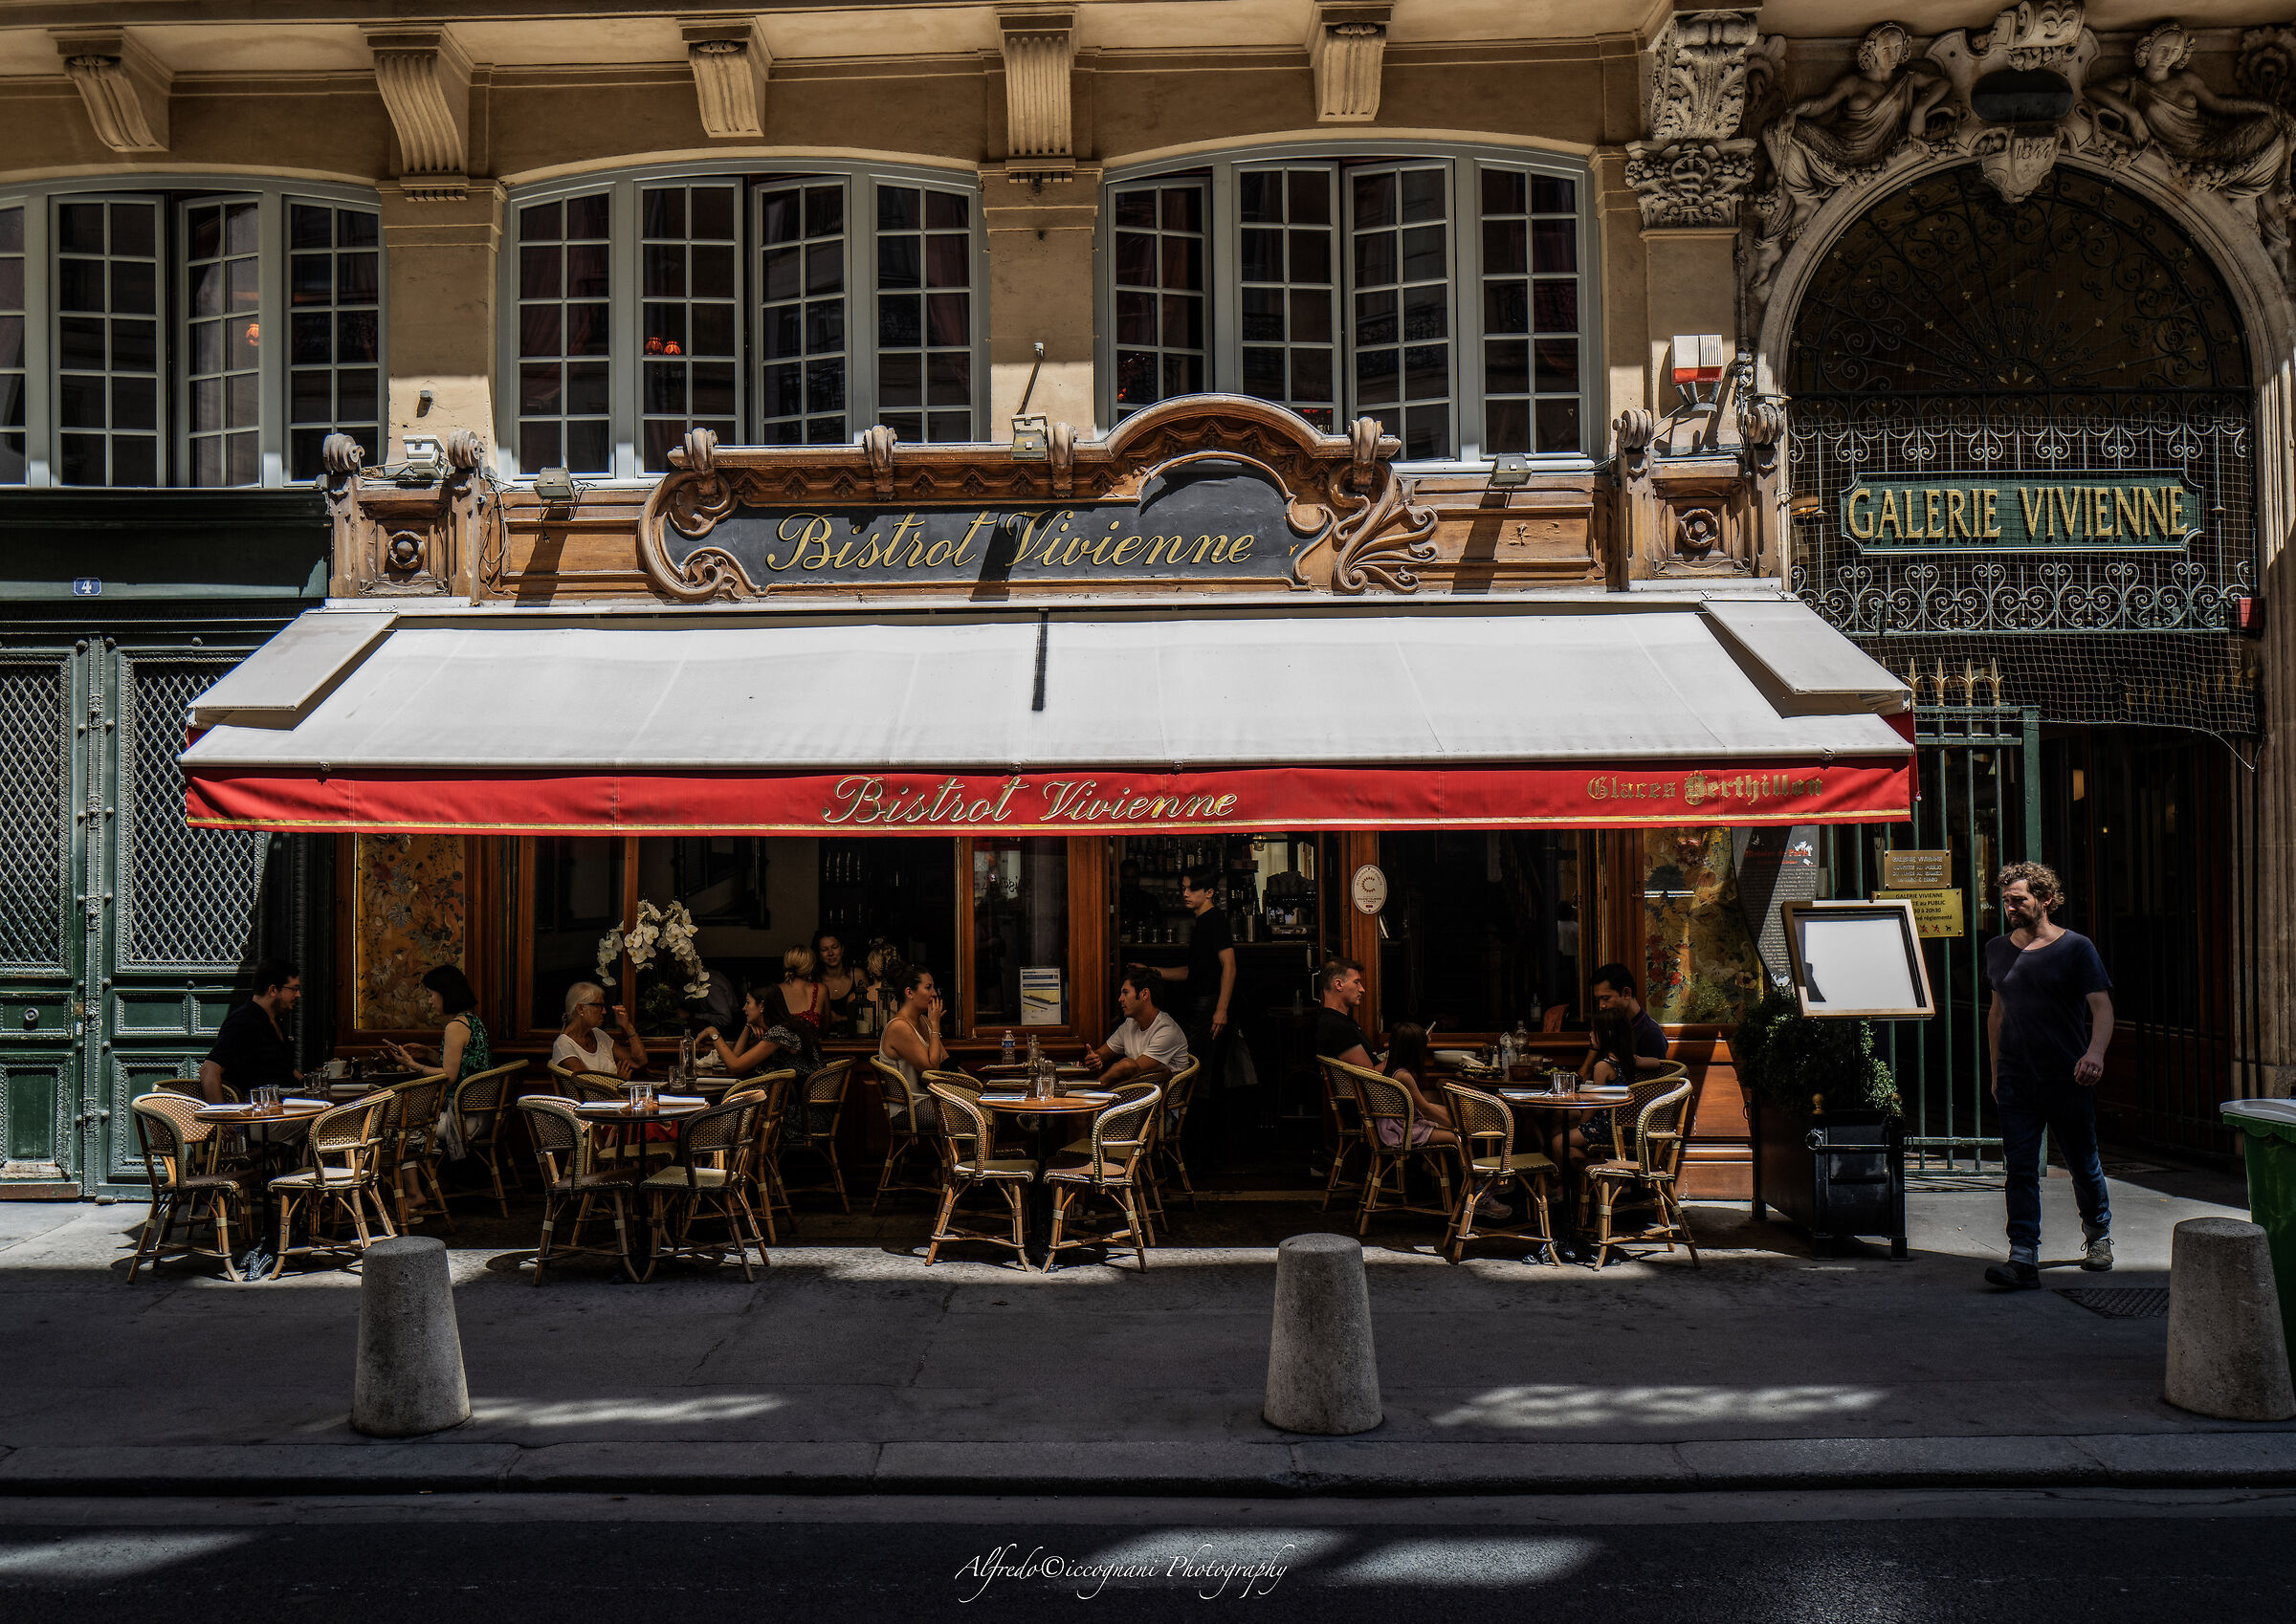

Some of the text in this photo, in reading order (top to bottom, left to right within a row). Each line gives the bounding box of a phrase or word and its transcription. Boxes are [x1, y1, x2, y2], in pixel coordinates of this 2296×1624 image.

[1848, 486, 2189, 539] GALERIE VIVIENNE
[765, 509, 1255, 570] Bistrot Vivienne
[80, 579, 93, 594] 4
[821, 775, 1238, 823] Bistrot Vivienne
[1587, 770, 1823, 806] Glaces Berthillon
[1788, 848, 1809, 857] Paris
